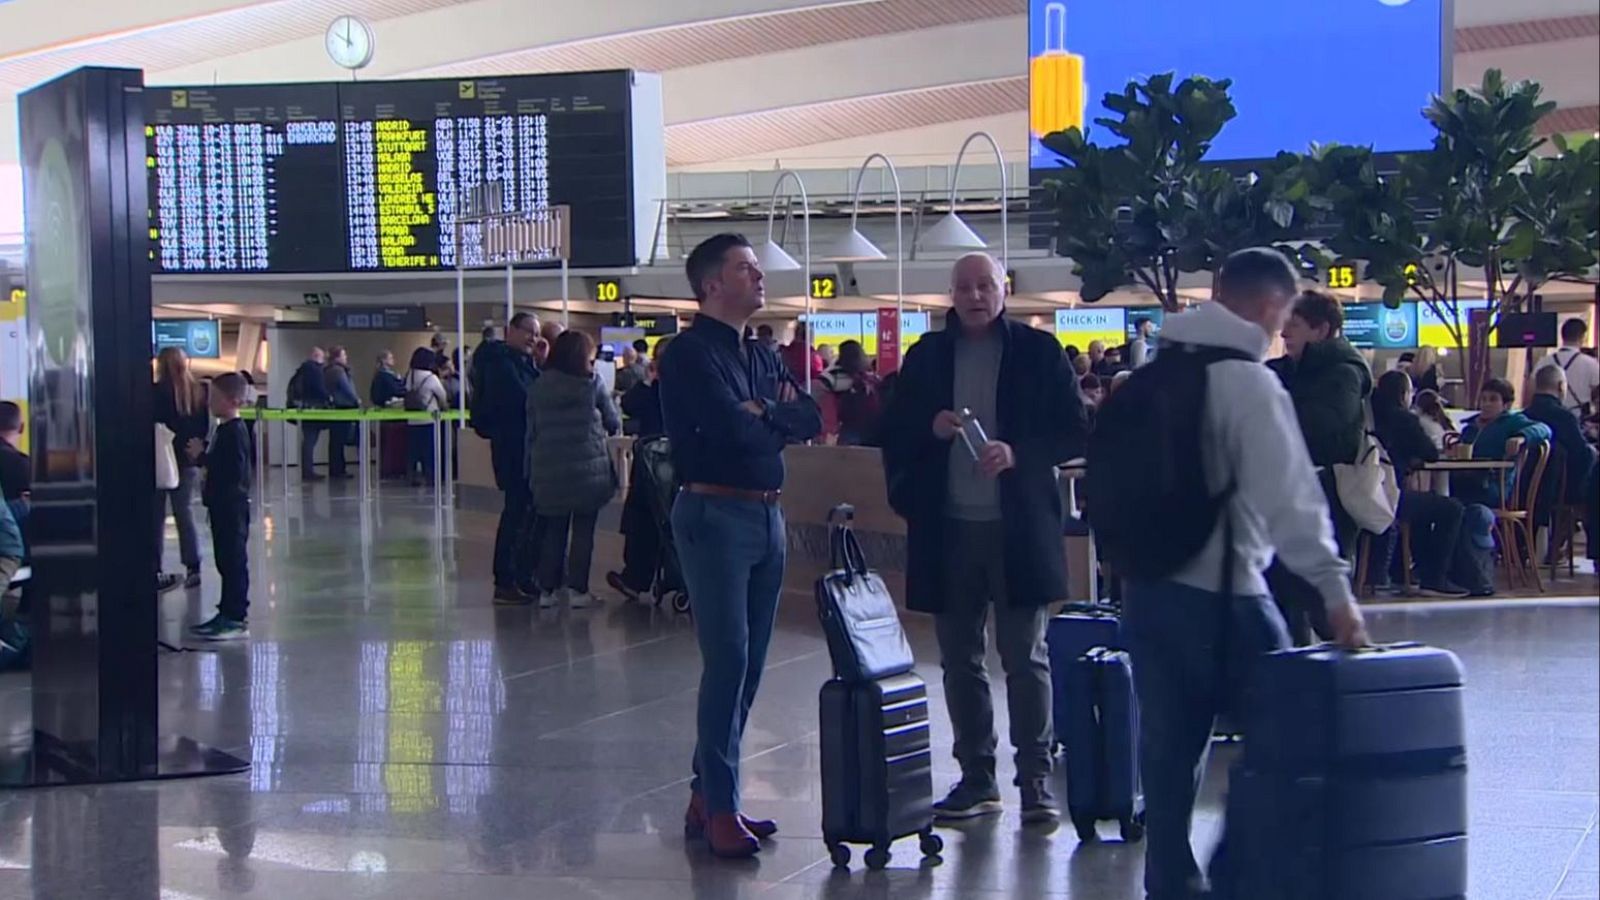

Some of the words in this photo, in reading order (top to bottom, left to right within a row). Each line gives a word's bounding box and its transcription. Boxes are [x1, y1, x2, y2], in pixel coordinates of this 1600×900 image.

[345, 122, 372, 132] 12:45
[484, 117, 512, 127] 21-22
[1328, 267, 1352, 287] 15
[598, 282, 618, 301] 10
[812, 279, 833, 298] 12
[1060, 314, 1106, 325] CHECK-IN
